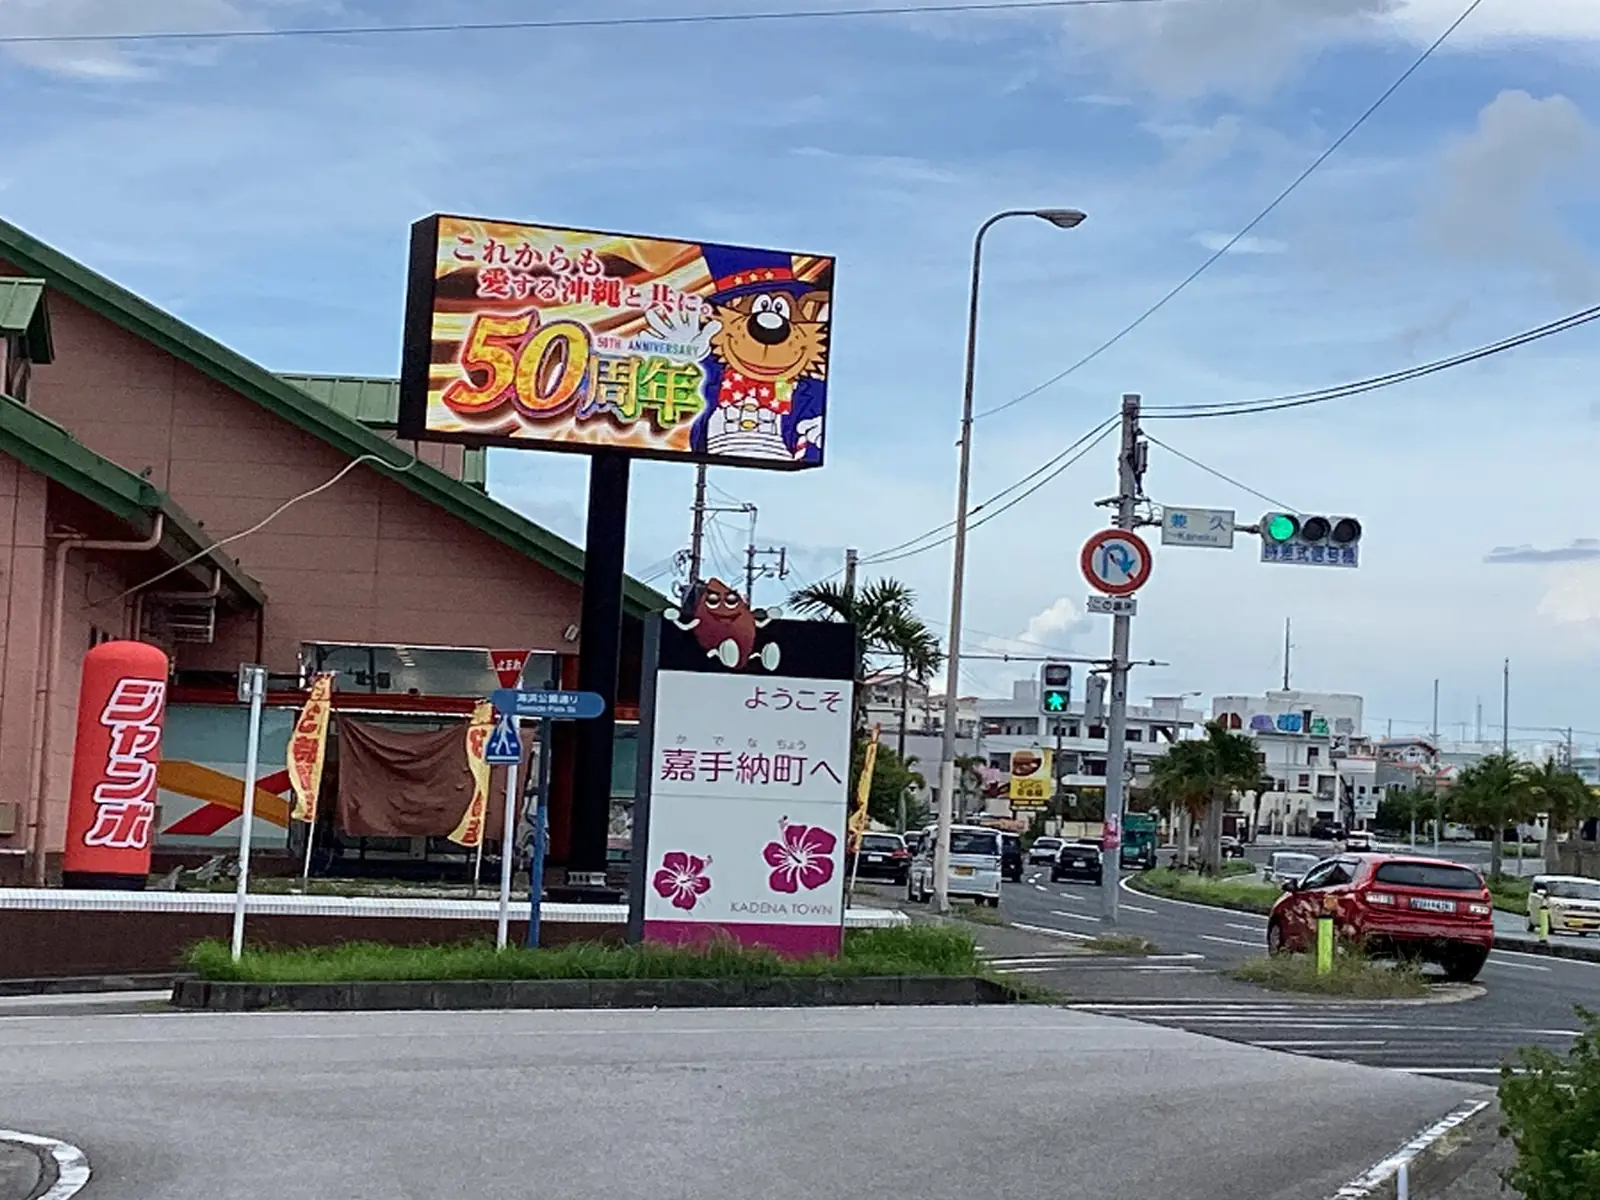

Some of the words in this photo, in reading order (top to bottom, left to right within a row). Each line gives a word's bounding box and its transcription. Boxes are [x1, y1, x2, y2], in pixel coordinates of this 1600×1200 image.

[453, 236, 601, 276] これからも
[627, 340, 700, 355] ANNIVERSARY
[744, 686, 843, 713] ようこそ
[85, 679, 165, 848] ジャンボ
[660, 748, 843, 787] 嘉手納町へ
[730, 901, 788, 914] KADENA
[792, 903, 833, 915] TOWN
